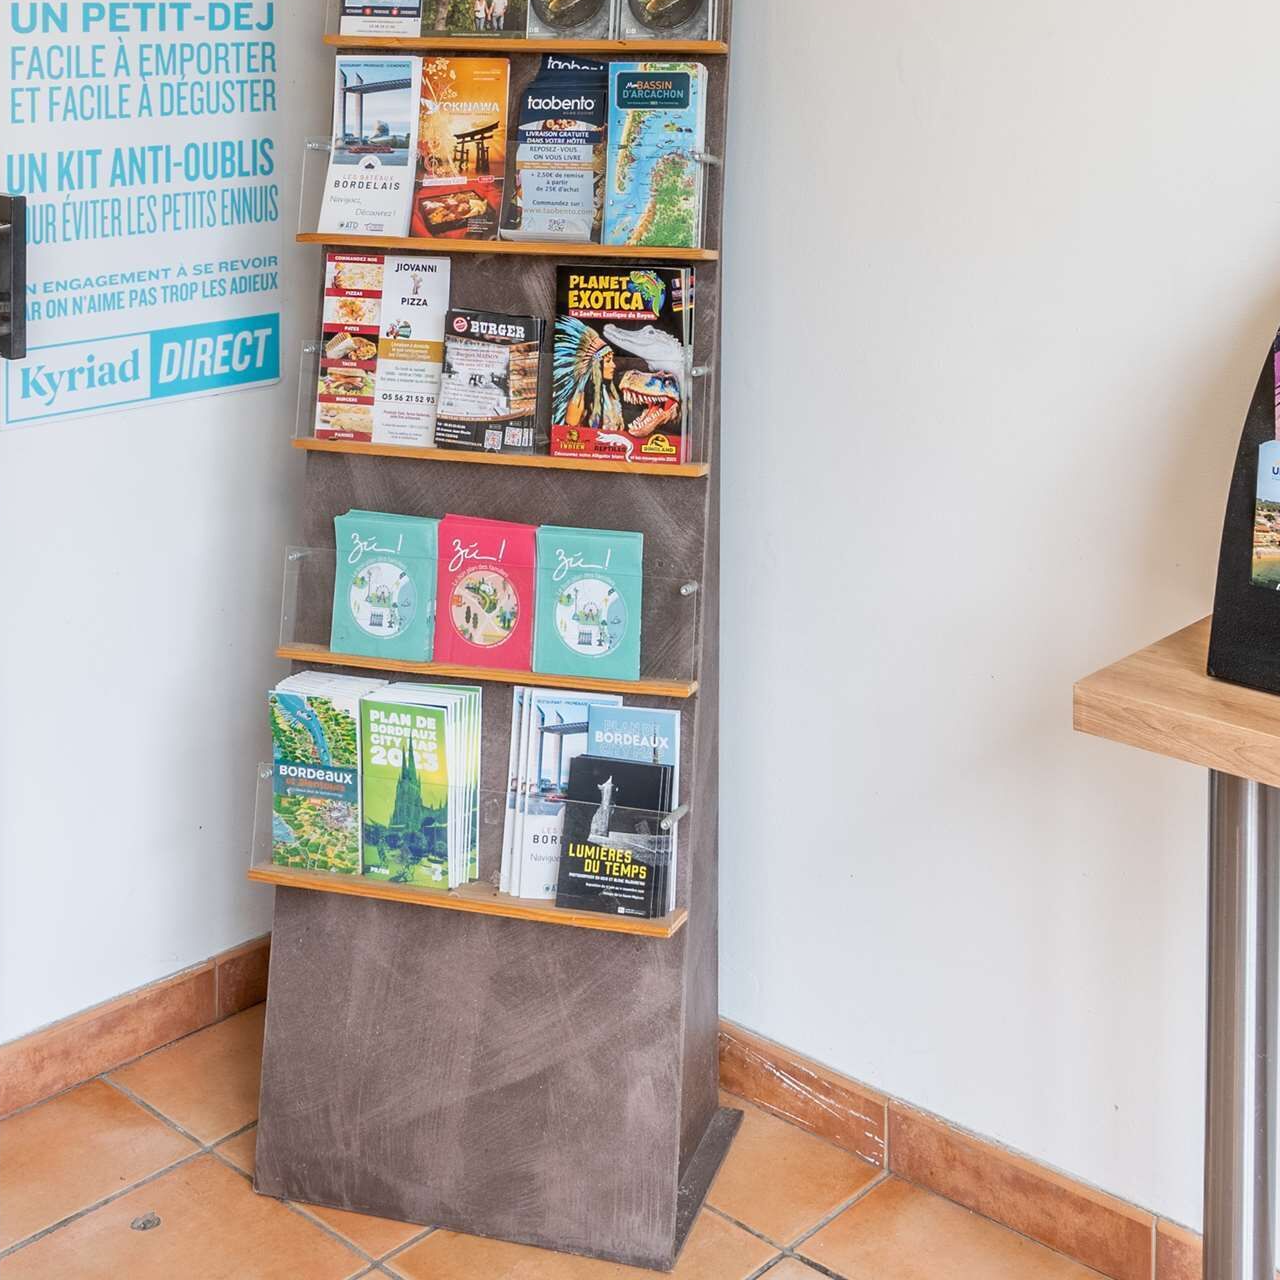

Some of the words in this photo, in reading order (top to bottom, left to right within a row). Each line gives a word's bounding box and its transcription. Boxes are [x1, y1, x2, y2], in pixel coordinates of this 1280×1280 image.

[11, 2, 68, 33] UN
[527, 96, 594, 110] taobento
[623, 90, 684, 99] D'ARCACHON
[6, 152, 47, 194] UN
[57, 148, 102, 192] KIT
[110, 137, 274, 187] ANTI-OUBLIS
[334, 181, 400, 190] BORDELAIS
[395, 263, 437, 272] JIOVANNI
[569, 275, 630, 290] PLANET
[401, 297, 428, 306] PIZZA
[569, 291, 645, 310] EXOTICA
[470, 320, 525, 338] BURGER
[158, 328, 272, 383] DIRECT
[20, 347, 140, 406] Kyriad
[381, 393, 392, 401] 05
[405, 394, 413, 402] 21
[426, 395, 435, 403] 93
[370, 710, 411, 725] PLAN
[416, 716, 436, 730] DE
[595, 731, 669, 749] BORDEAUX
[584, 860, 600, 873] DU
[606, 862, 647, 879] TEMPS
